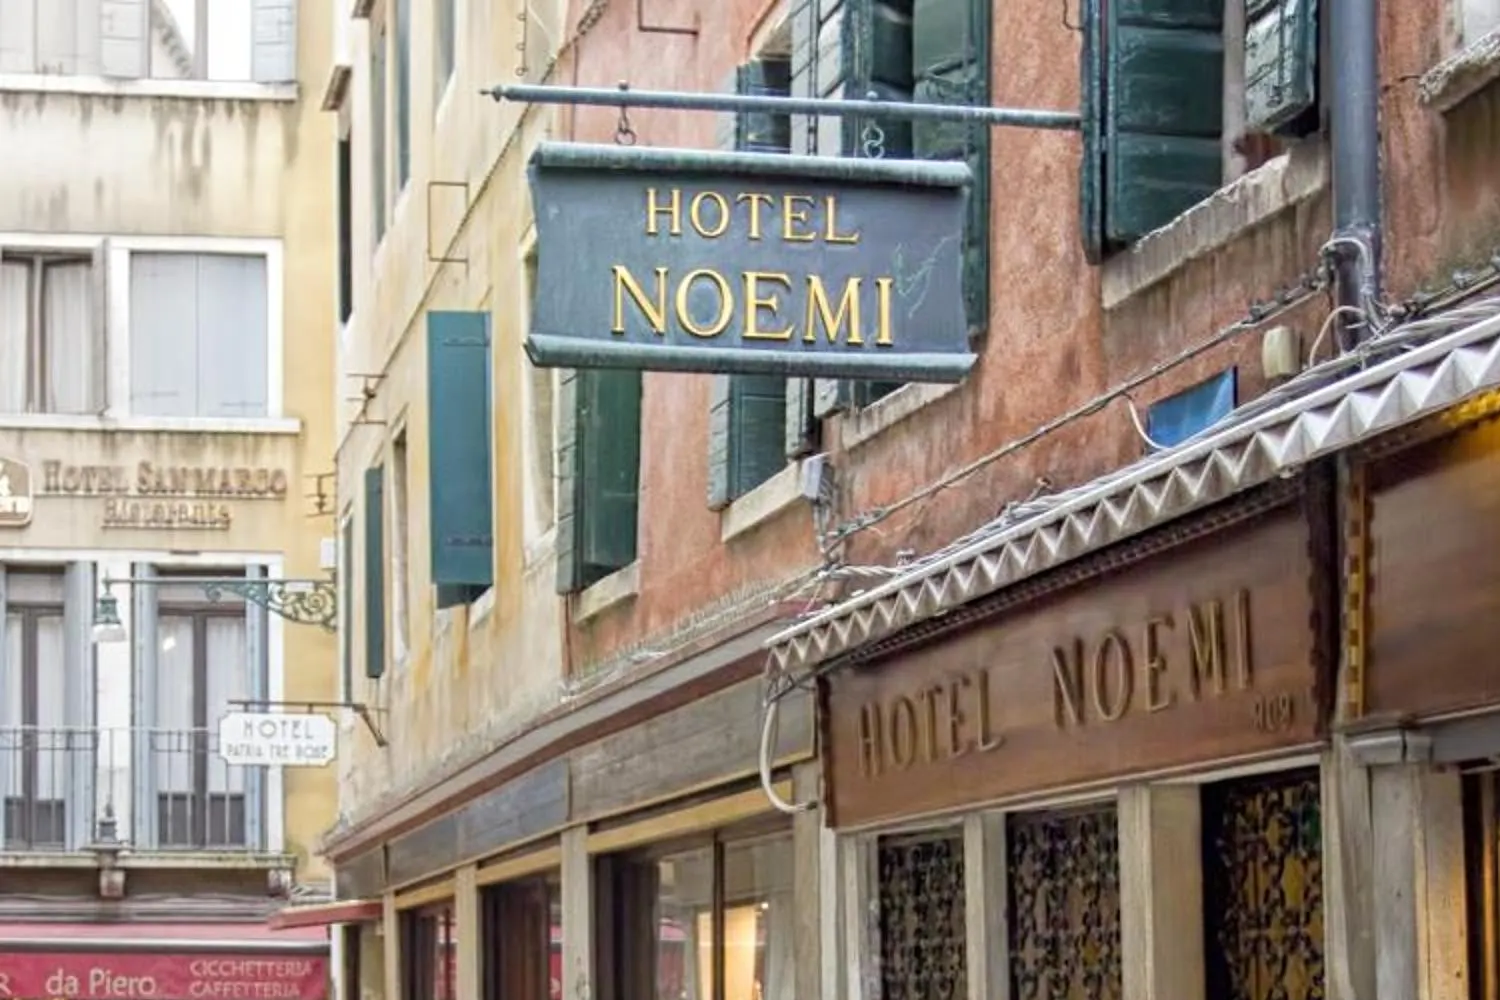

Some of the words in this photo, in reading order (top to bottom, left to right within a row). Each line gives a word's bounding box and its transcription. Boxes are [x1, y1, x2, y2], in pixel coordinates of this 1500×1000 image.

[645, 187, 861, 245] HOTEL
[610, 264, 896, 347] NOEMI
[858, 666, 1006, 778] HOTEL
[1051, 588, 1255, 730] NOEMI
[243, 720, 315, 740] HOTEL
[45, 968, 79, 996] da
[89, 969, 156, 997] Piero
[189, 960, 313, 978] CICCHETTERIA
[189, 980, 301, 999] CAFFETTERIA
